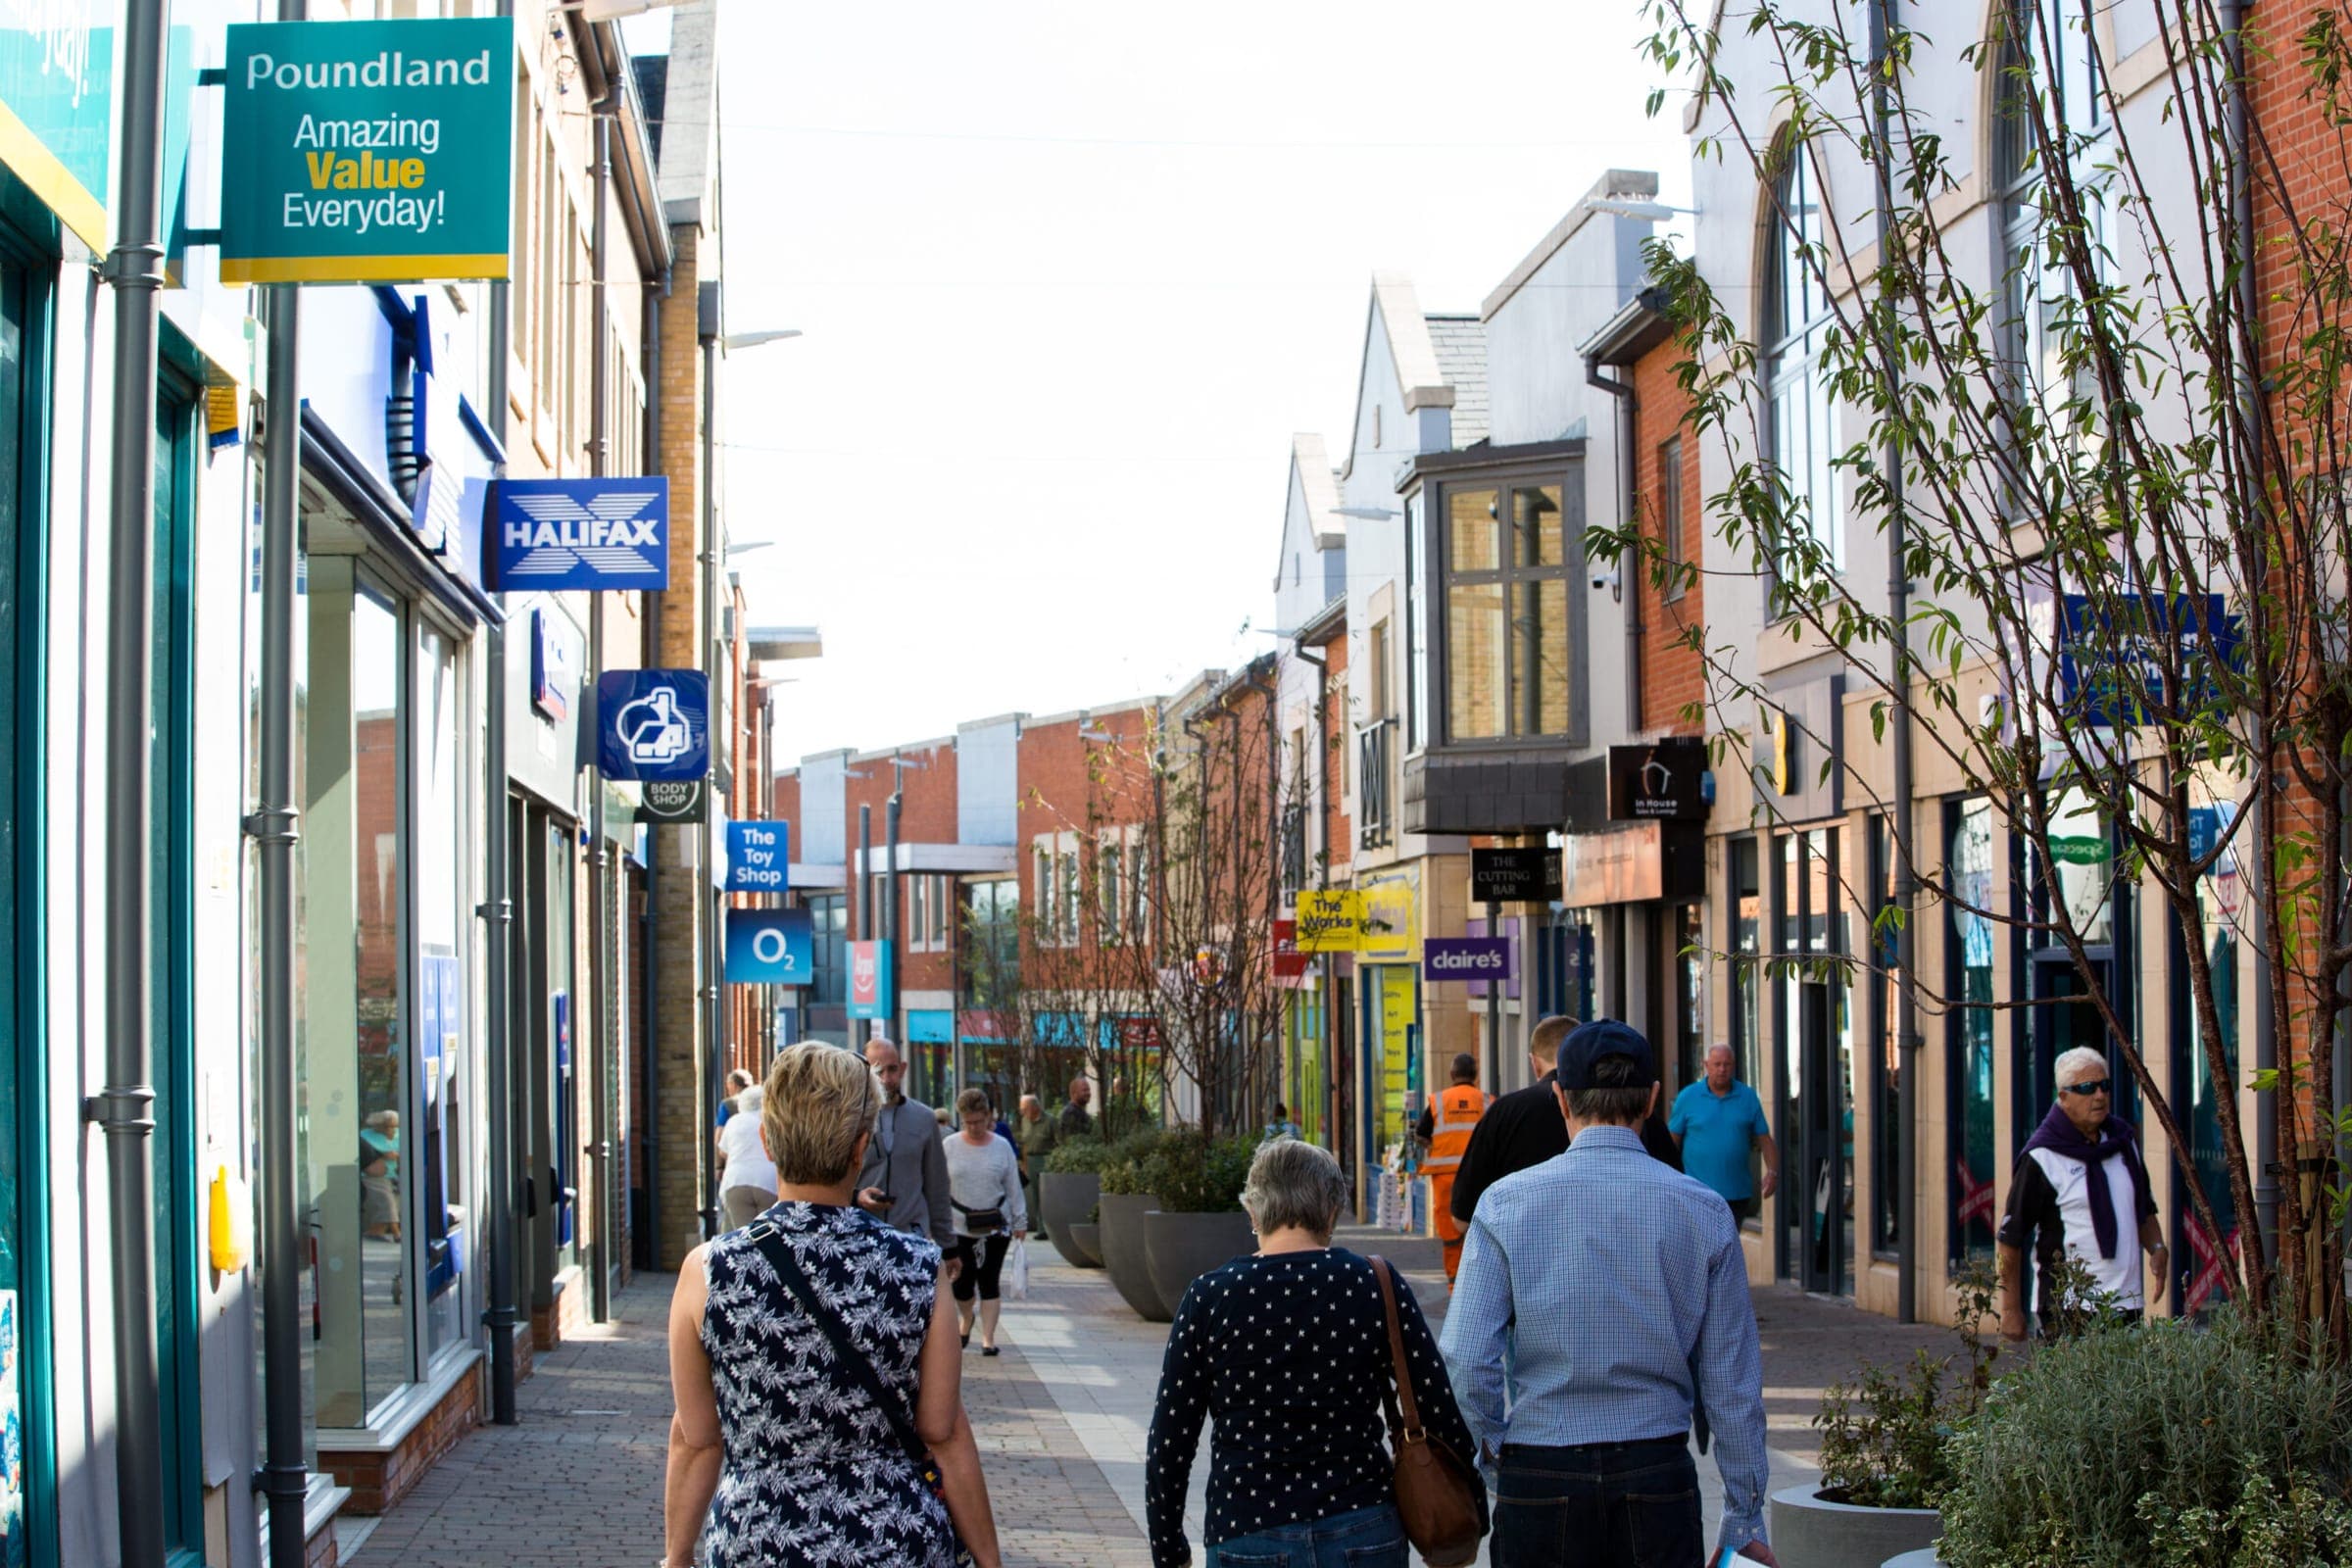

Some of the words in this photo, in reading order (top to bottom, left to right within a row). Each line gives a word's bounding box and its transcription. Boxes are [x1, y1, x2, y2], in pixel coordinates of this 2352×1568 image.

[247, 49, 490, 90] Poundland
[293, 112, 440, 155] Amazing
[306, 150, 425, 190] Value
[283, 189, 445, 234] Everyday!
[504, 519, 661, 548] HALIFAX
[651, 783, 688, 794] BODY
[653, 795, 687, 806] SHOP
[742, 827, 776, 845] The
[744, 848, 774, 867] Toy
[1492, 856, 1517, 867] THE
[736, 867, 782, 886] Shop
[1478, 869, 1530, 882] CUTTING
[1493, 884, 1517, 895] BAR
[1314, 899, 1343, 912] The
[1303, 914, 1352, 929] Works
[1432, 949, 1502, 969] claire's
